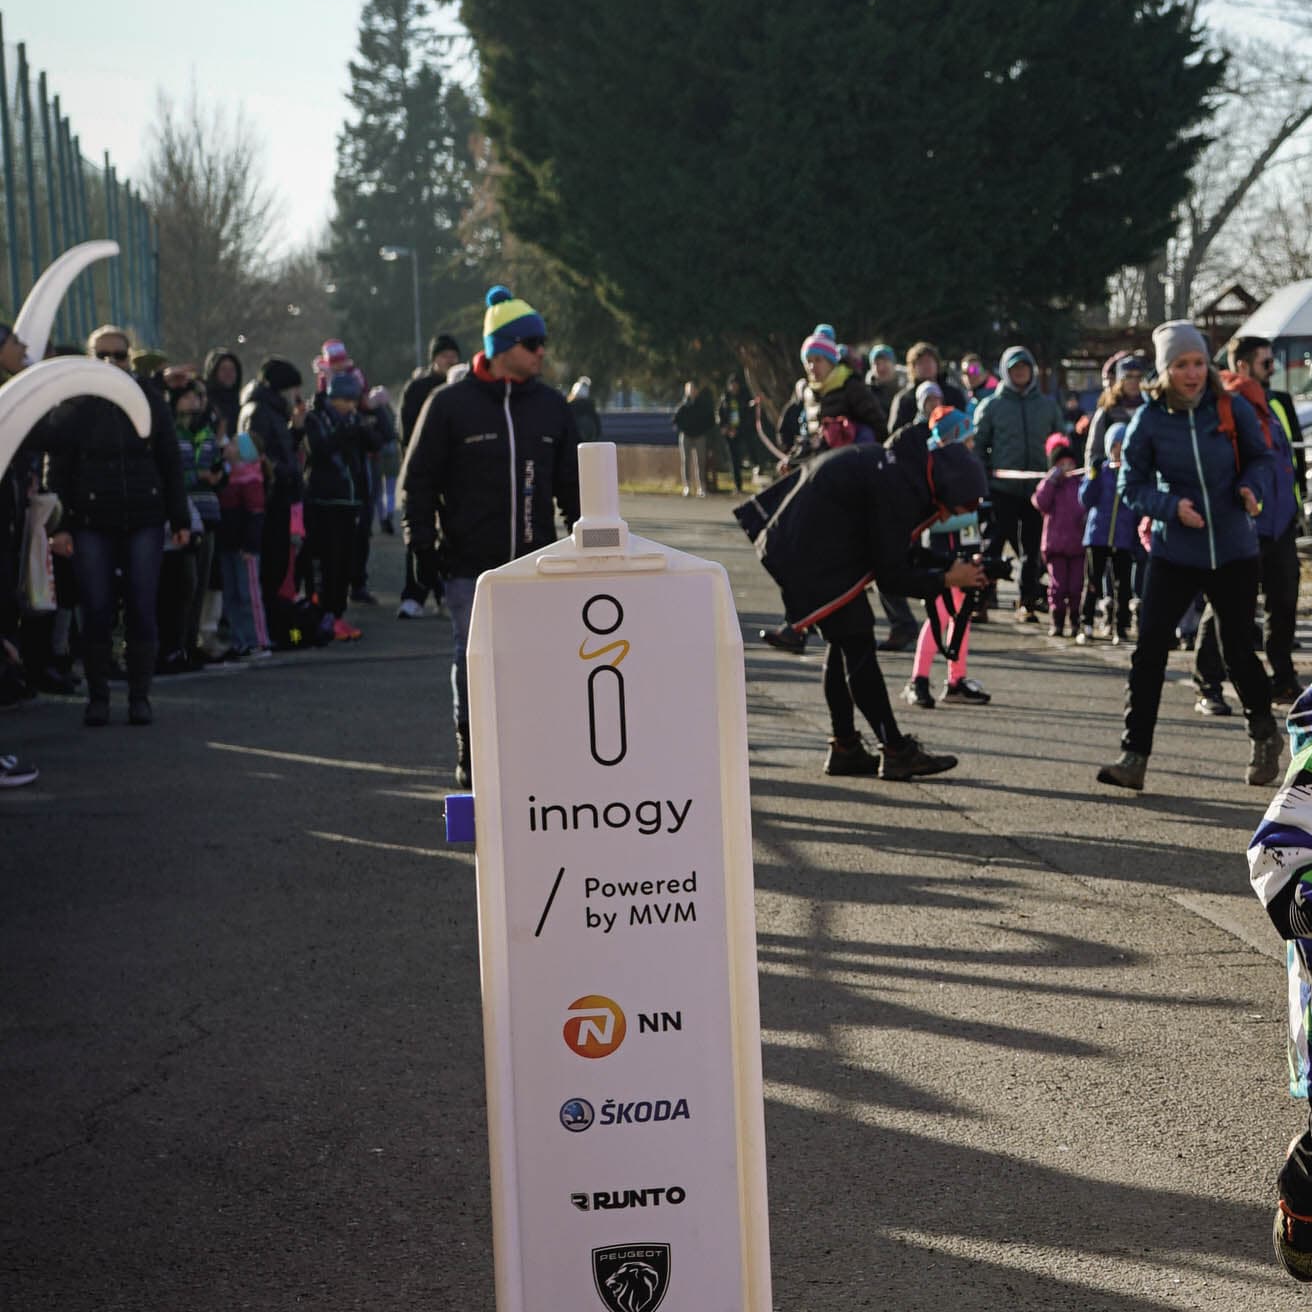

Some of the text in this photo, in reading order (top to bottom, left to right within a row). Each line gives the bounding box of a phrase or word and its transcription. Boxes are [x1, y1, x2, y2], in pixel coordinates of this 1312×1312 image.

[528, 795, 693, 835] innogy
[584, 870, 697, 899] Powered
[585, 901, 697, 934] by MVM
[637, 1010, 682, 1034] NN
[600, 1098, 691, 1126] ŠKODA
[593, 1186, 687, 1211] RUNTO
[600, 1249, 664, 1262] PEUGEOT
